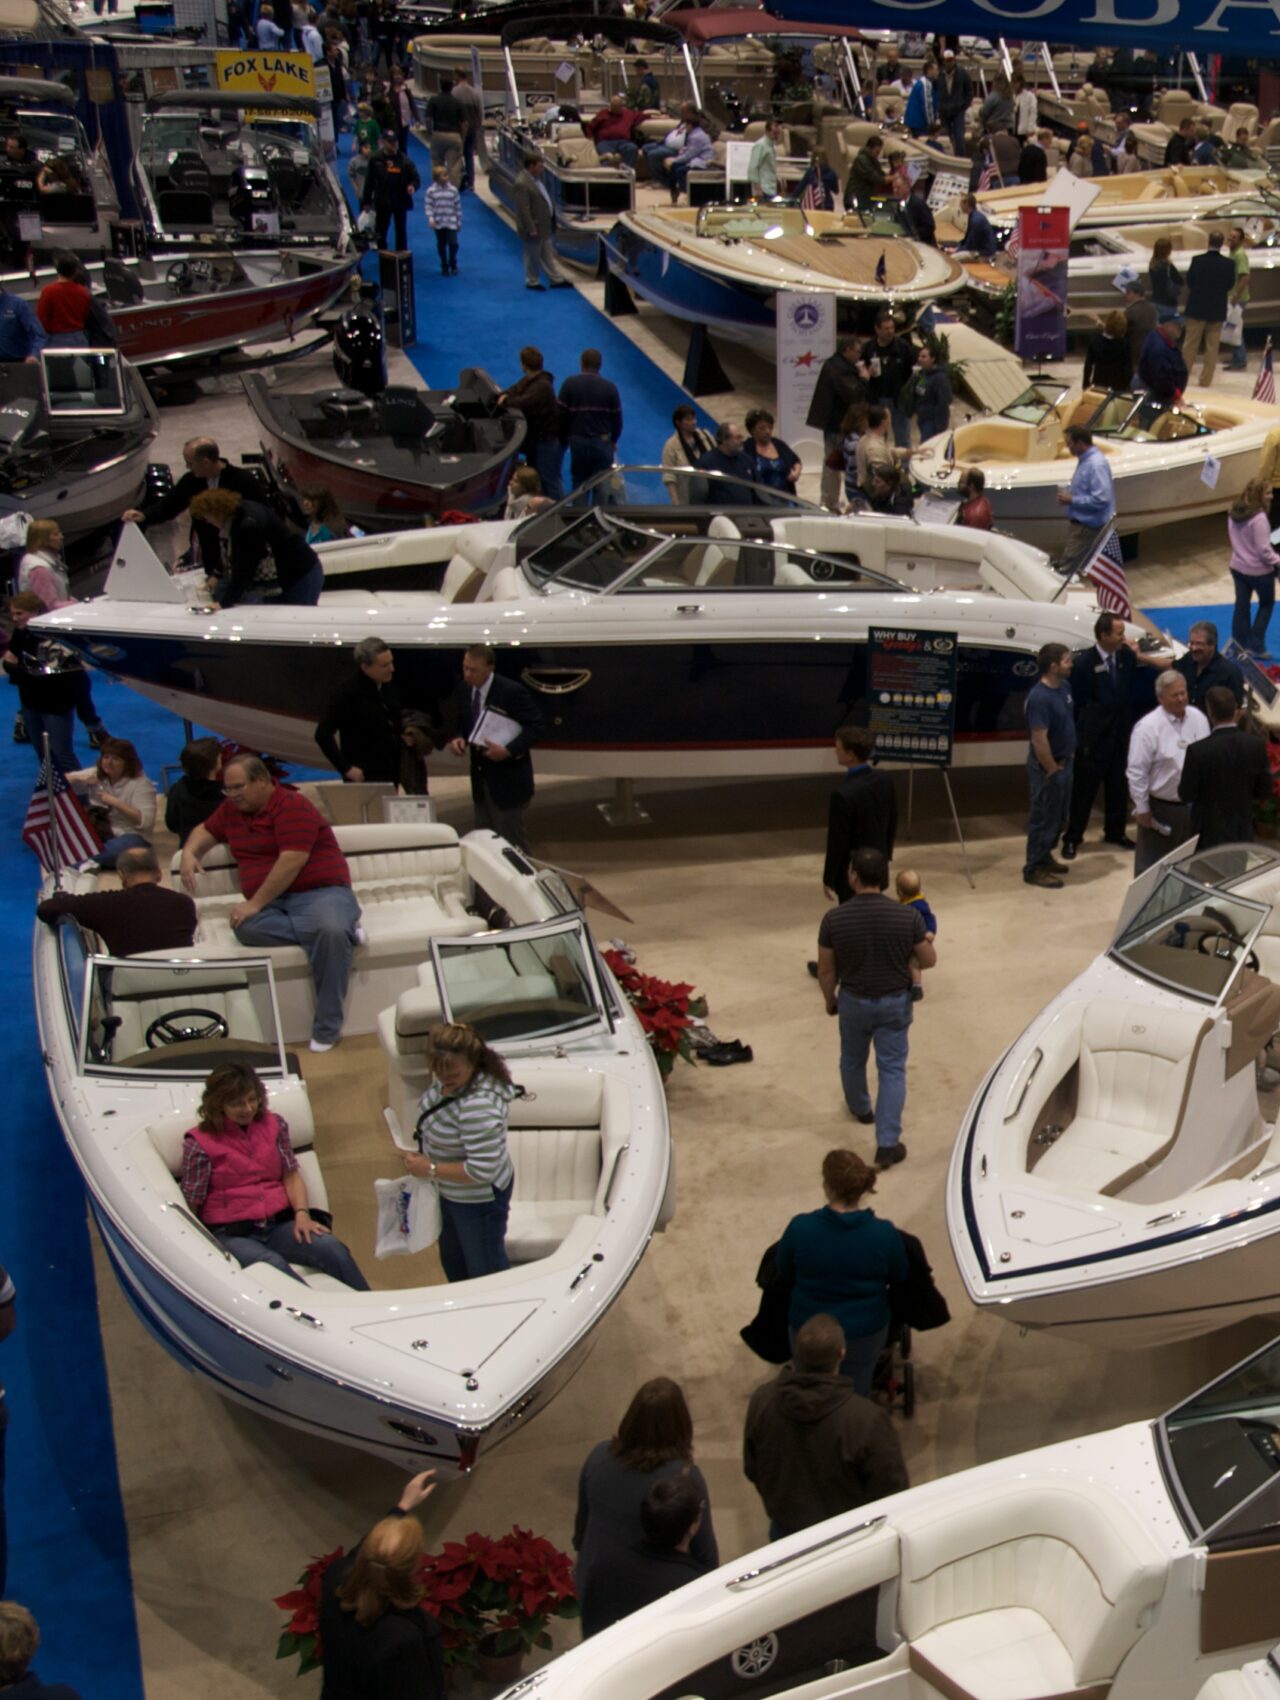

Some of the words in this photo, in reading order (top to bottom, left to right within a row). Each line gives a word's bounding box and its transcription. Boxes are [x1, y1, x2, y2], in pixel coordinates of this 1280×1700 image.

[223, 57, 257, 82] FOX
[263, 57, 310, 84] LAKE
[872, 630, 894, 641] WHY
[896, 632, 917, 642] BUY
